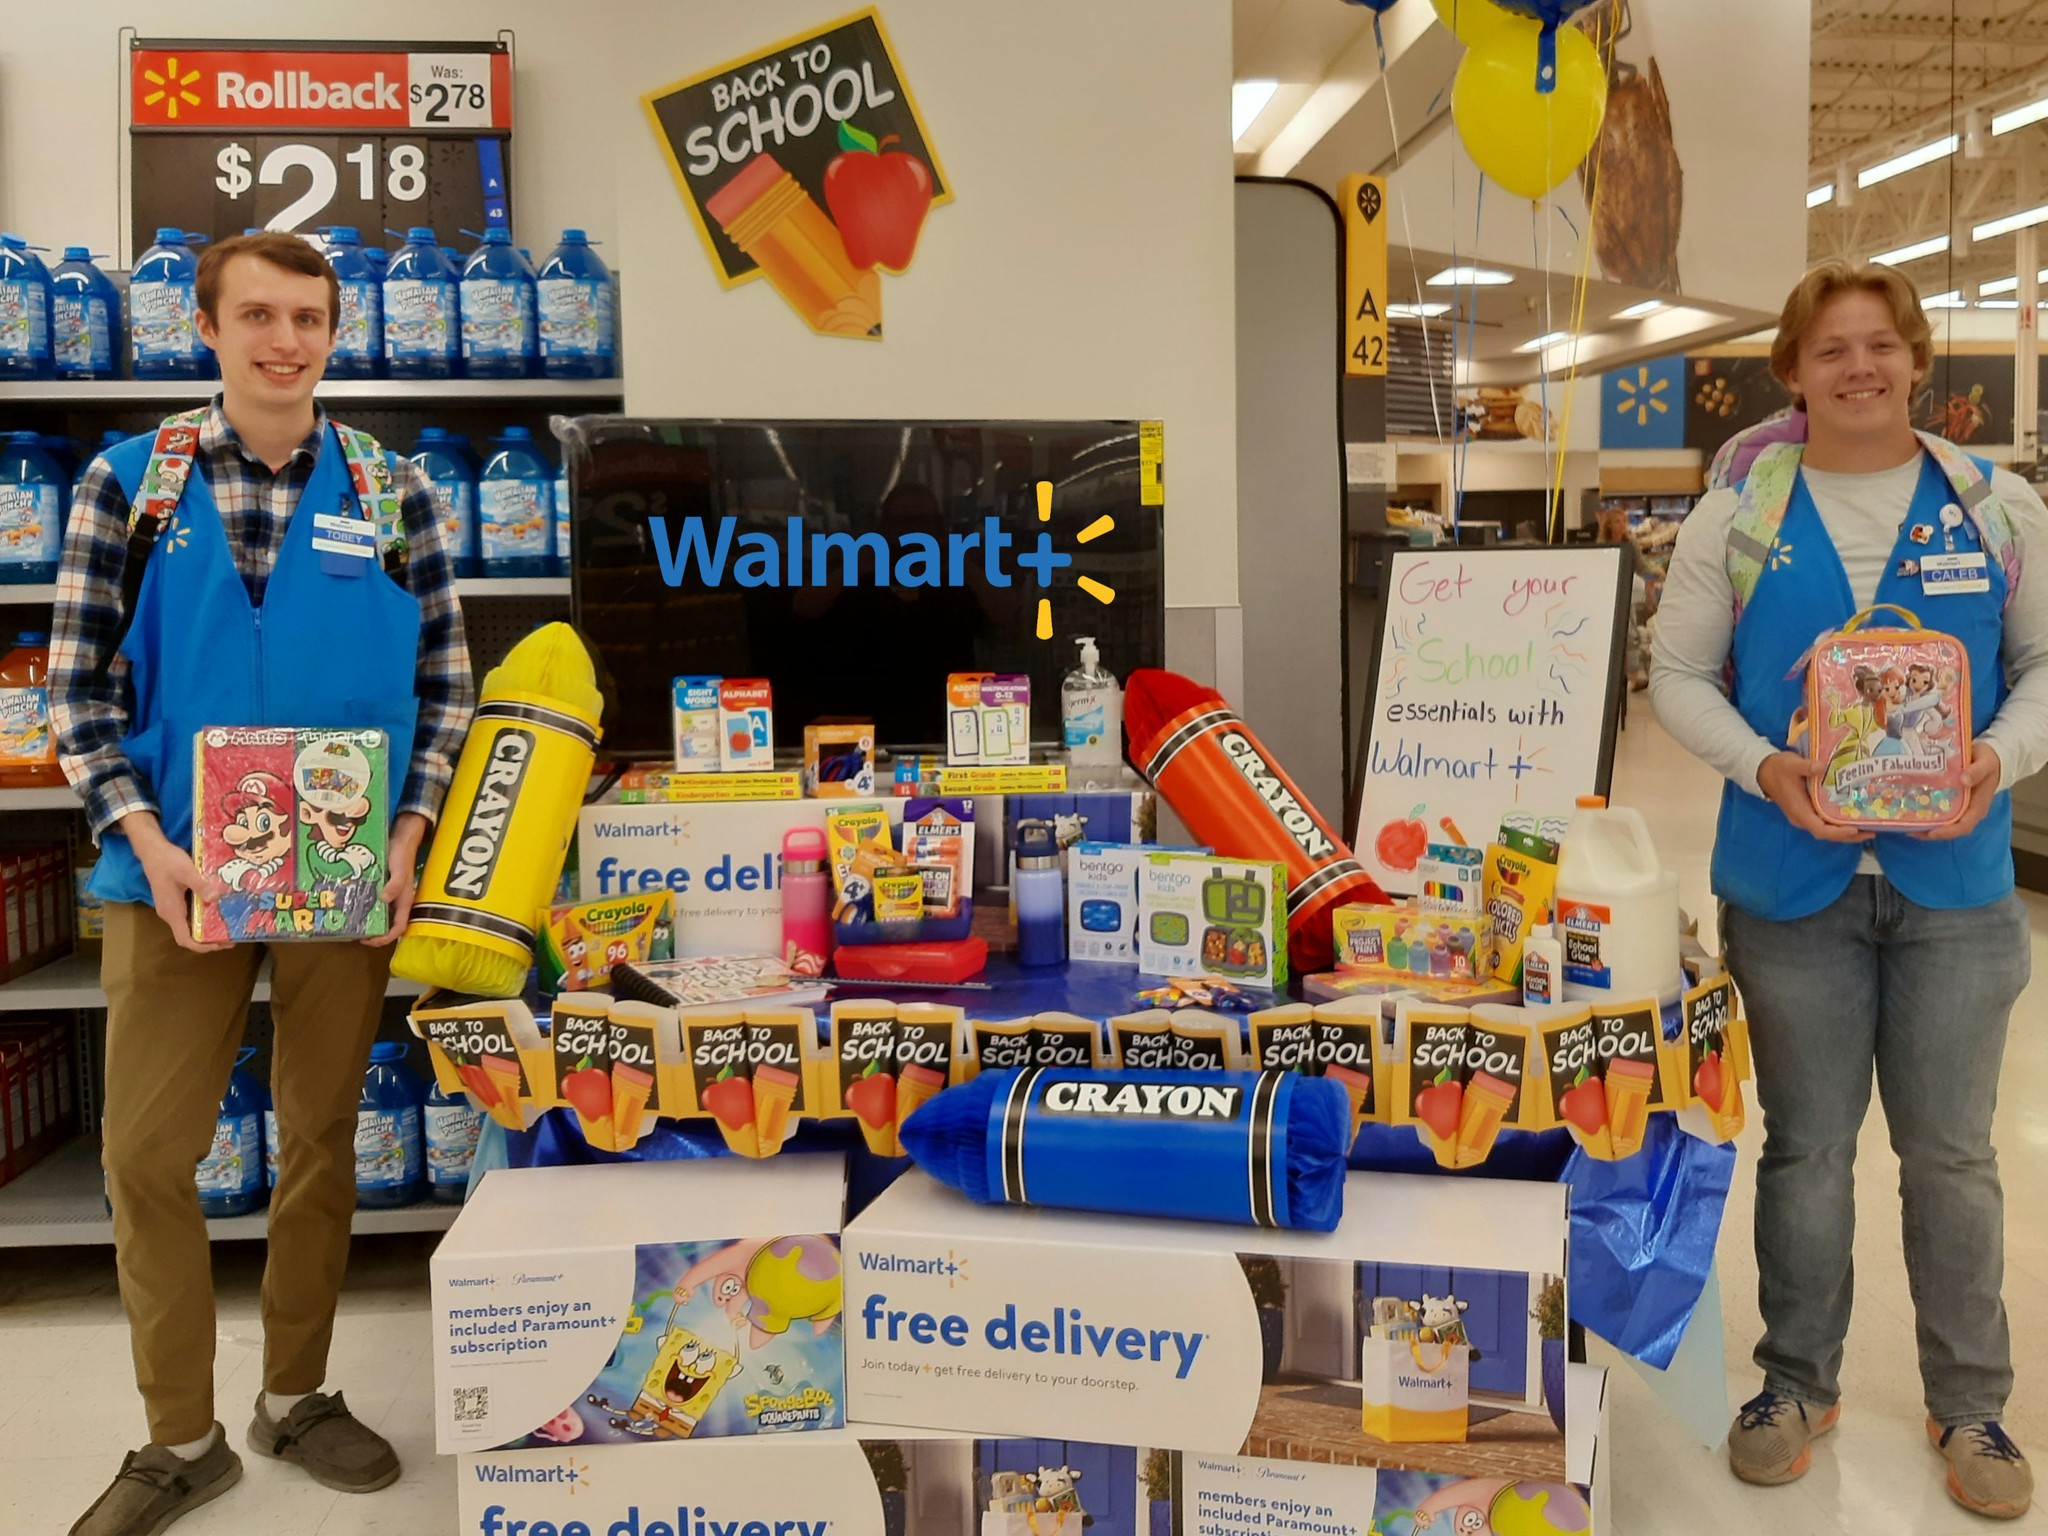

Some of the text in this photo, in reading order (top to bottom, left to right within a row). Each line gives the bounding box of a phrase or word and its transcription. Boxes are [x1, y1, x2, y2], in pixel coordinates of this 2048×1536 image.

[430, 65, 465, 79] Was:
[711, 43, 832, 113] BACK TO
[216, 70, 402, 111] Rollback
[684, 60, 896, 177] SCHOOL
[488, 178, 499, 189] A
[488, 208, 503, 219] 43
[1355, 289, 1381, 323] A
[1352, 336, 1384, 367] 42
[326, 529, 363, 544] TOBEY
[1931, 567, 1978, 582] CALEB
[1399, 561, 1579, 616] Get your
[1416, 637, 1534, 685] School
[684, 697, 718, 705] WORDS
[687, 688, 714, 697] SIGHT
[723, 689, 769, 699] ALPHABET
[1386, 698, 1565, 726] essentials with
[750, 715, 765, 732] A
[948, 771, 968, 779] First
[970, 770, 997, 779] Grade
[1837, 755, 1942, 787] Feelin' Fabulous!
[676, 789, 730, 799] Kindergarten
[944, 784, 972, 793] Second
[973, 784, 997, 792] Grade
[1221, 732, 1334, 857] CRAYON
[962, 799, 973, 810] 12
[448, 732, 529, 897] CRAYON
[838, 817, 878, 827] Crayola
[594, 822, 682, 839] Walmart+
[918, 825, 960, 835] ELMER'S
[1499, 832, 1508, 845] 50
[1079, 860, 1124, 876] bentgo
[1500, 853, 1528, 873] Crayola
[596, 853, 783, 895] free deli
[935, 872, 950, 880] ON
[1088, 872, 1108, 881] kids
[1149, 870, 1191, 887] bentgo
[881, 880, 915, 889] Crayola
[922, 881, 948, 890] RPLE
[1157, 884, 1176, 893] kids
[260, 890, 337, 909] SUPER
[246, 908, 347, 934] MARIO
[586, 901, 646, 923] Crayola
[679, 908, 701, 918] free
[703, 906, 745, 919] delivery
[747, 906, 758, 917] to
[1486, 900, 1522, 925] COLORED
[1492, 918, 1518, 943] ENCILS
[1566, 917, 1599, 931] ELMER'S
[607, 943, 627, 962] 96
[1355, 944, 1378, 955] PAINT
[1568, 938, 1598, 954] School
[1454, 955, 1466, 968] 10
[1712, 990, 1722, 1006] TO
[430, 1020, 483, 1037] BACK TO
[565, 1017, 628, 1040] BACK TO
[703, 1026, 772, 1043] BACK TO
[851, 1021, 925, 1040] BACK TO
[1272, 1024, 1343, 1043] BACK TO
[1425, 1026, 1497, 1048] BACK TO
[1559, 1018, 1625, 1048] BACK TO
[556, 1033, 655, 1066] SCHOOL
[840, 1035, 949, 1064] SCHOOL
[989, 1033, 1064, 1047] BACK TO
[1131, 1033, 1195, 1050] BACK TO
[694, 1040, 800, 1067] SCHOOL
[981, 1045, 1090, 1066] SCHOOL
[1124, 1045, 1224, 1072] SCHOOL
[1263, 1038, 1372, 1067] SCHOOL
[1412, 1041, 1521, 1076] SCHOOL
[1551, 1030, 1655, 1073] SCHOOL
[1045, 1082, 1239, 1118] CRAYON
[859, 1252, 959, 1276] Walmart+
[449, 1276, 496, 1288] Walmart+
[449, 1300, 592, 1320] members enjoy an
[449, 1315, 617, 1337] included Paramount+
[450, 1337, 548, 1356] subscription
[862, 1294, 1203, 1380] free delivery
[861, 1358, 885, 1371] Join
[888, 1360, 921, 1376] today
[934, 1364, 954, 1378] get
[957, 1364, 981, 1378] free
[984, 1367, 1031, 1385] delivery
[1035, 1371, 1048, 1383] to
[1051, 1374, 1079, 1388] your
[1081, 1376, 1140, 1393] doorstep.
[1398, 1374, 1453, 1391] Walmart+
[475, 1464, 579, 1484] Walmart+
[1198, 1491, 1333, 1518] members enjoy an
[480, 1505, 592, 1536] free
[1198, 1504, 1357, 1536] included Paramount+
